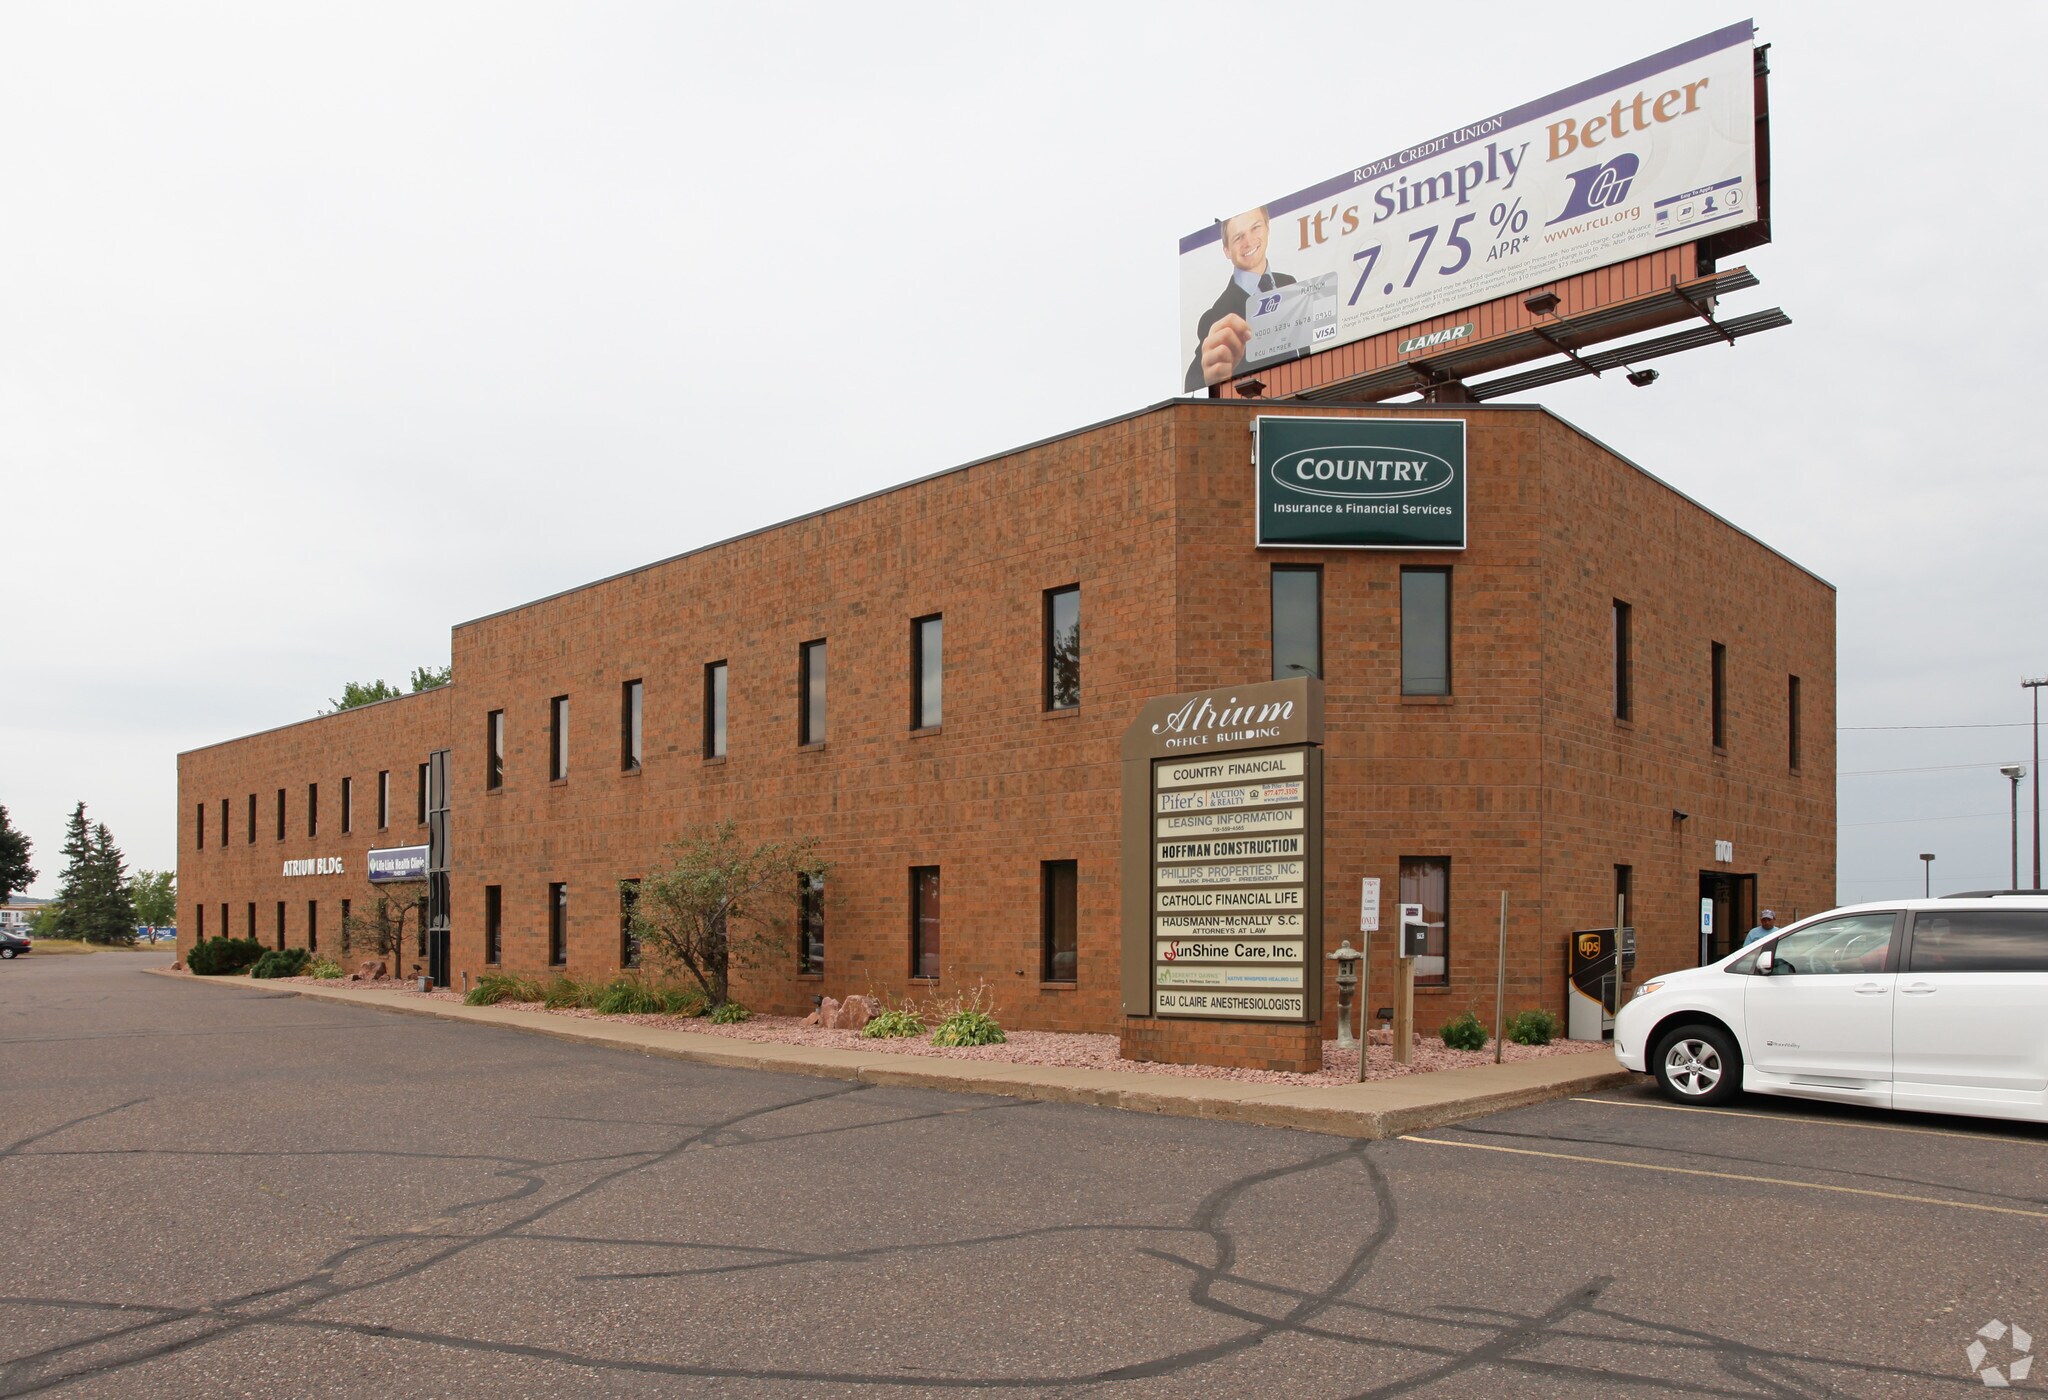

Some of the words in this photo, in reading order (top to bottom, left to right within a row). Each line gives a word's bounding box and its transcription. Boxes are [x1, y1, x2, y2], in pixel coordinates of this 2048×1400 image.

[1353, 158, 1396, 183] ROYAL
[1399, 137, 1448, 164] CREDIT
[1453, 116, 1503, 144] UNION
[1297, 204, 1359, 251] It's
[1372, 142, 1530, 224] Simply
[1545, 78, 1709, 162] Better
[1544, 206, 1640, 244] www.rcu.org
[1347, 212, 1476, 306] 7.75
[1315, 327, 1335, 338] VISA
[1406, 326, 1465, 352] LAMAR
[1296, 458, 1428, 482] COUNTRY
[1274, 503, 1332, 514] Insurance
[1336, 504, 1343, 514] &
[1346, 503, 1399, 514] Financial
[1402, 504, 1452, 515] Services
[1152, 696, 1295, 734] Atrium
[1166, 734, 1208, 748] OFFICE
[1217, 726, 1280, 743] BUILDING
[1173, 766, 1224, 780] COUNTRY
[1228, 760, 1286, 775] FINANCIAL
[1162, 793, 1204, 810] Pifer's
[1210, 789, 1245, 799] AUCTION
[1218, 798, 1244, 807] REALTY
[1168, 816, 1212, 828] LEASING
[1217, 810, 1292, 824] INFORMATION
[1162, 843, 1211, 858] HOFFMAN
[1214, 839, 1298, 856] CONSTRUCTION
[1715, 840, 1732, 862] 1101
[283, 858, 316, 876] ATRIUM
[317, 857, 344, 874] BLDG.
[385, 859, 394, 870] Link
[395, 858, 410, 869] Health
[1162, 867, 1203, 879] PHILLIPS
[1208, 864, 1272, 877] PROPERTIES
[1278, 864, 1299, 874] INC.
[1162, 894, 1212, 906] CATHOLIC
[1216, 893, 1272, 905] FINANCIAL
[1275, 892, 1298, 904] LIFE
[1162, 916, 1273, 926] HAUSMANN-McNALLY
[1278, 916, 1299, 925] S.C.
[1164, 940, 1229, 960] SunShine
[1235, 944, 1270, 958] Care,
[1273, 945, 1297, 957] Inc.
[1580, 941, 1599, 955] ups
[1160, 995, 1176, 1006] EAU
[1178, 996, 1207, 1008] CLAIRE
[1211, 997, 1301, 1011] ANESTHESIOLOGISTS
